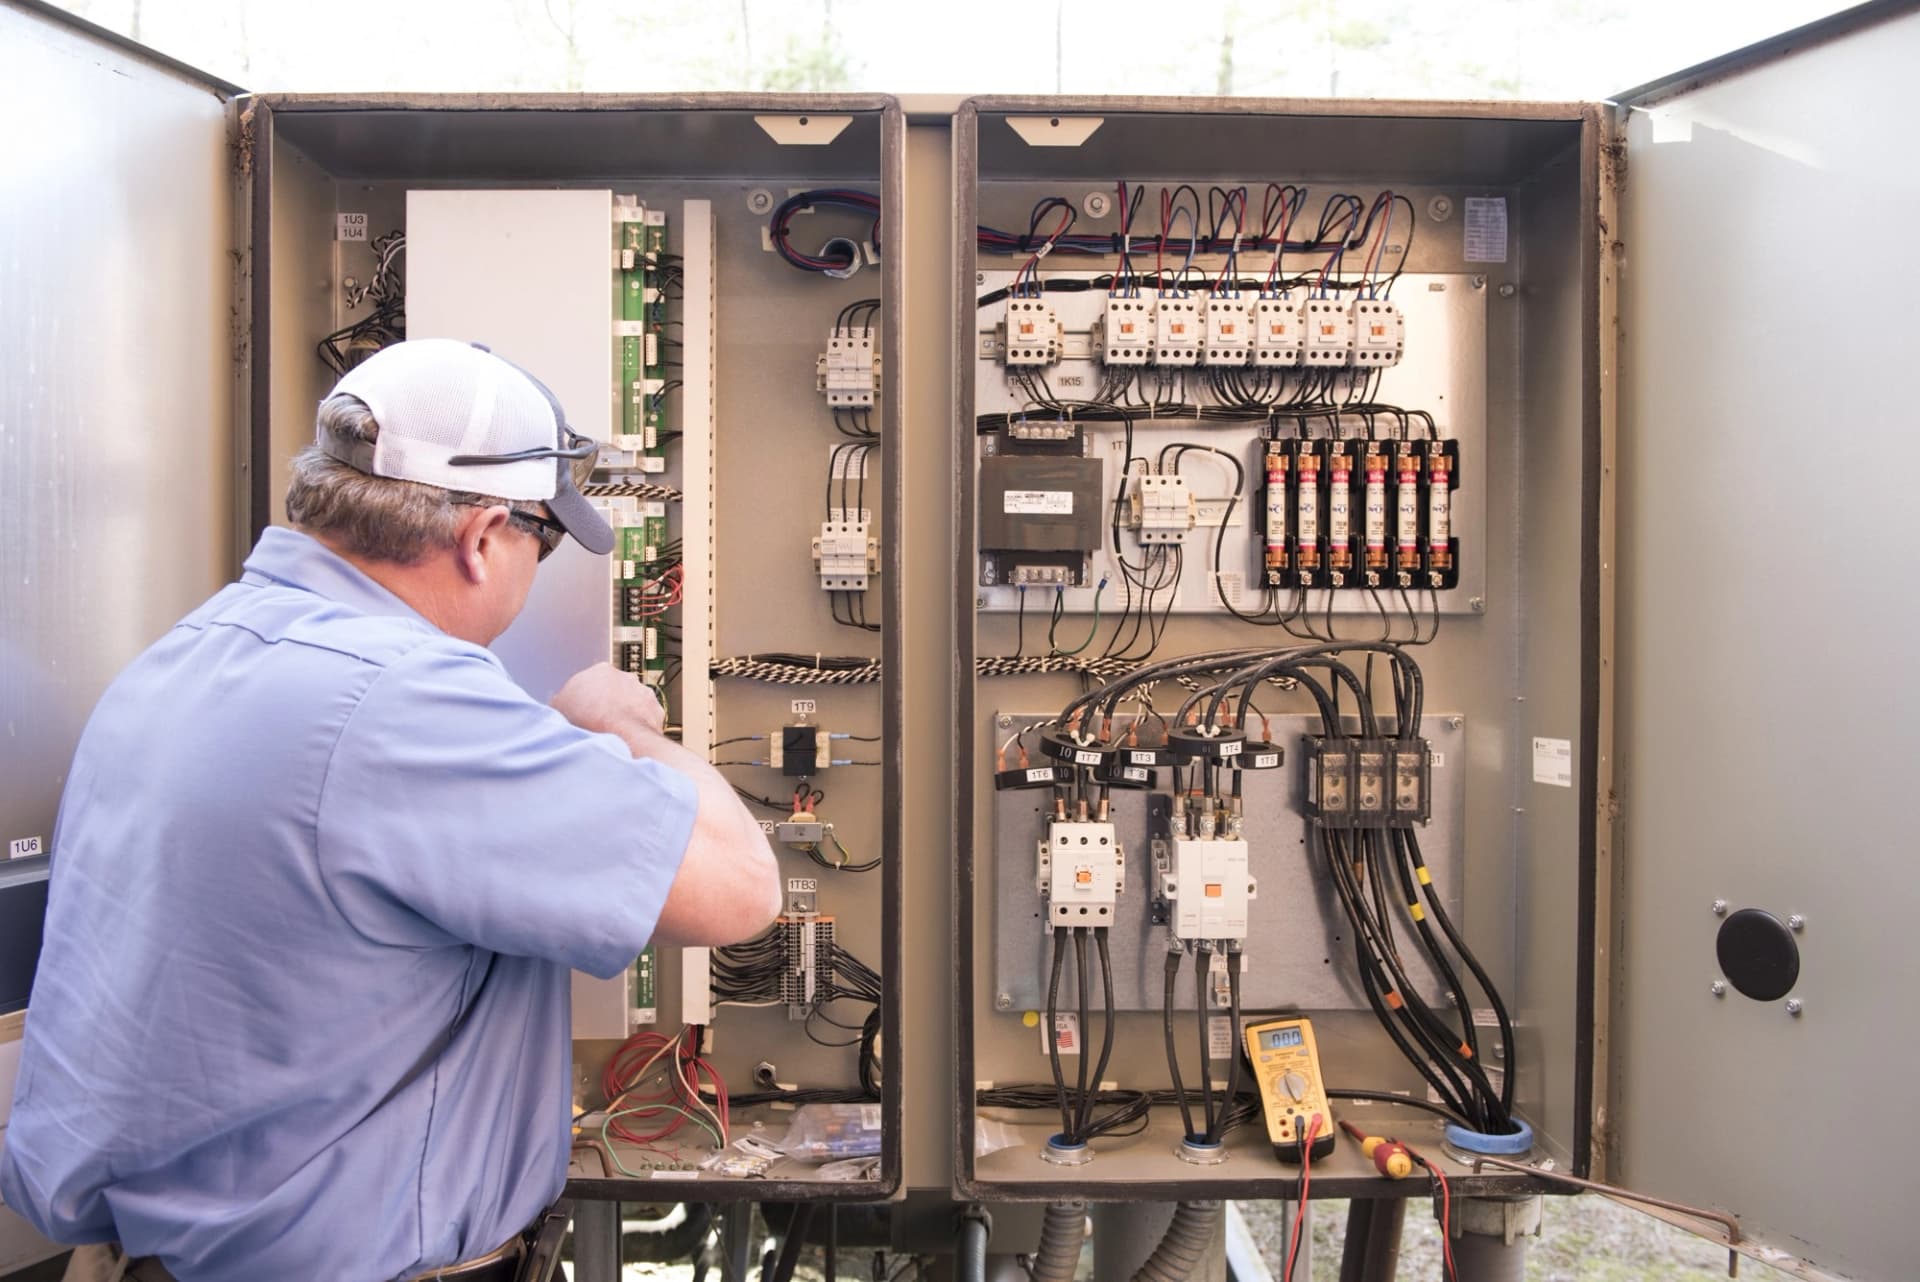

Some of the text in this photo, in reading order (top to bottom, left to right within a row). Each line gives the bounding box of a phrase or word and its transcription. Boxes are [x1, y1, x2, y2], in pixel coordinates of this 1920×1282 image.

[344, 215, 364, 225] 1U3
[343, 227, 362, 237] 1U4
[1060, 376, 1081, 387] 1K15
[794, 701, 814, 712] 1T9
[1060, 746, 1072, 758] 10
[1136, 753, 1151, 762] 1T3
[1082, 753, 1099, 763] 1T7
[1032, 770, 1049, 779] 1T6
[1060, 767, 1069, 778] 10
[1109, 766, 1121, 777] 10
[757, 822, 773, 832] T2
[15, 839, 38, 853] 1U6
[789, 879, 816, 890] 1TB3
